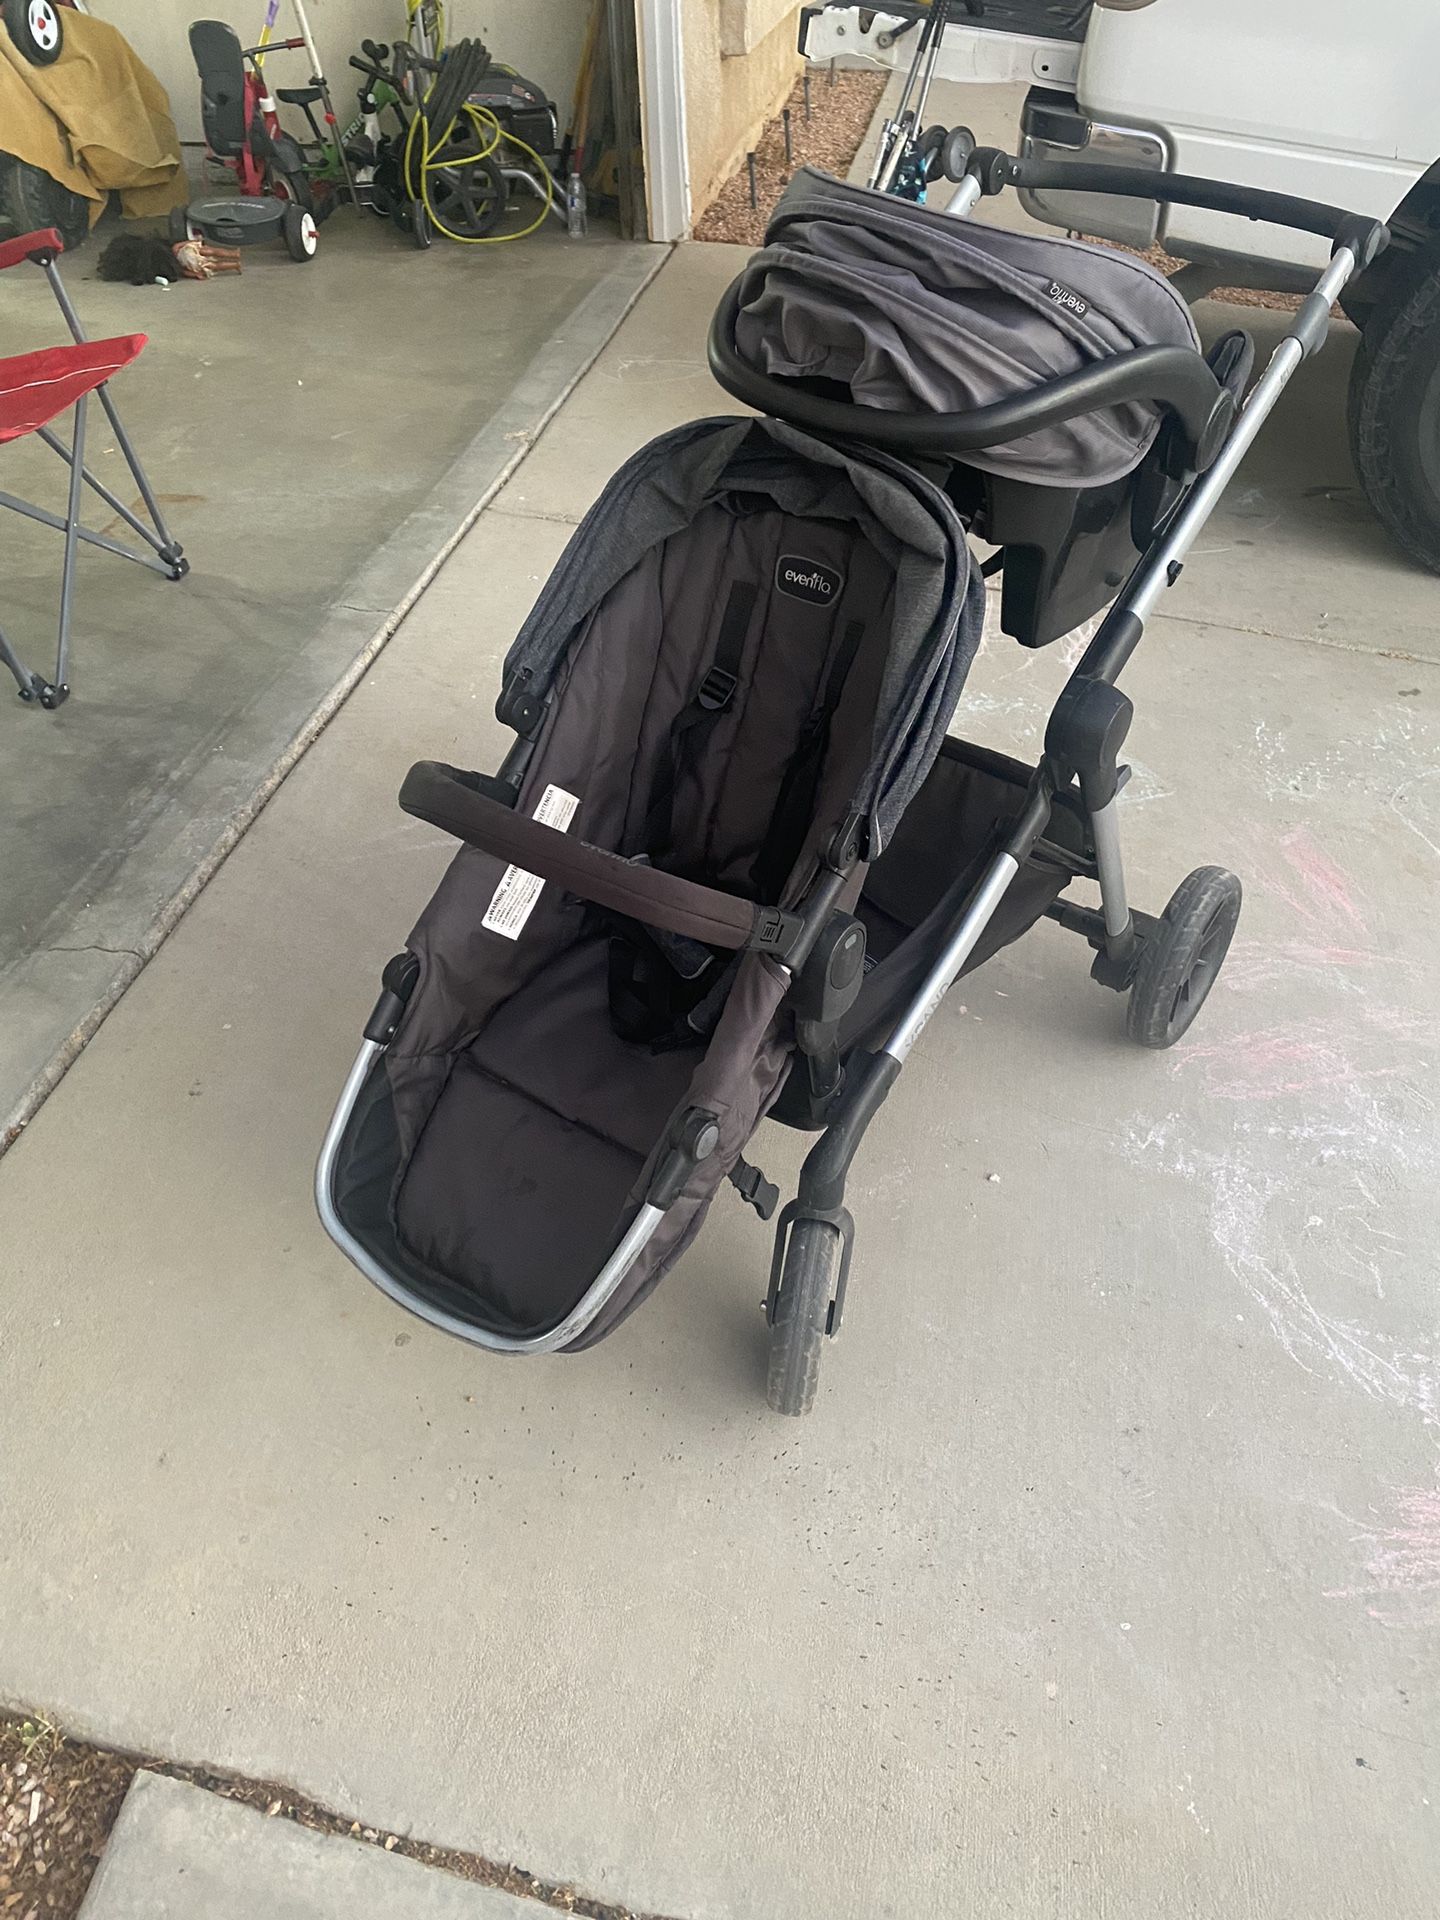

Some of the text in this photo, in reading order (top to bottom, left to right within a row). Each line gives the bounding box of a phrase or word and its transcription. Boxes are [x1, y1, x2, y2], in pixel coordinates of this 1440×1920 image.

[1050, 285, 1086, 313] evenflo
[784, 569, 831, 593] evenflo
[538, 789, 554, 821] VERTENCIA
[489, 888, 507, 915] WARNING
